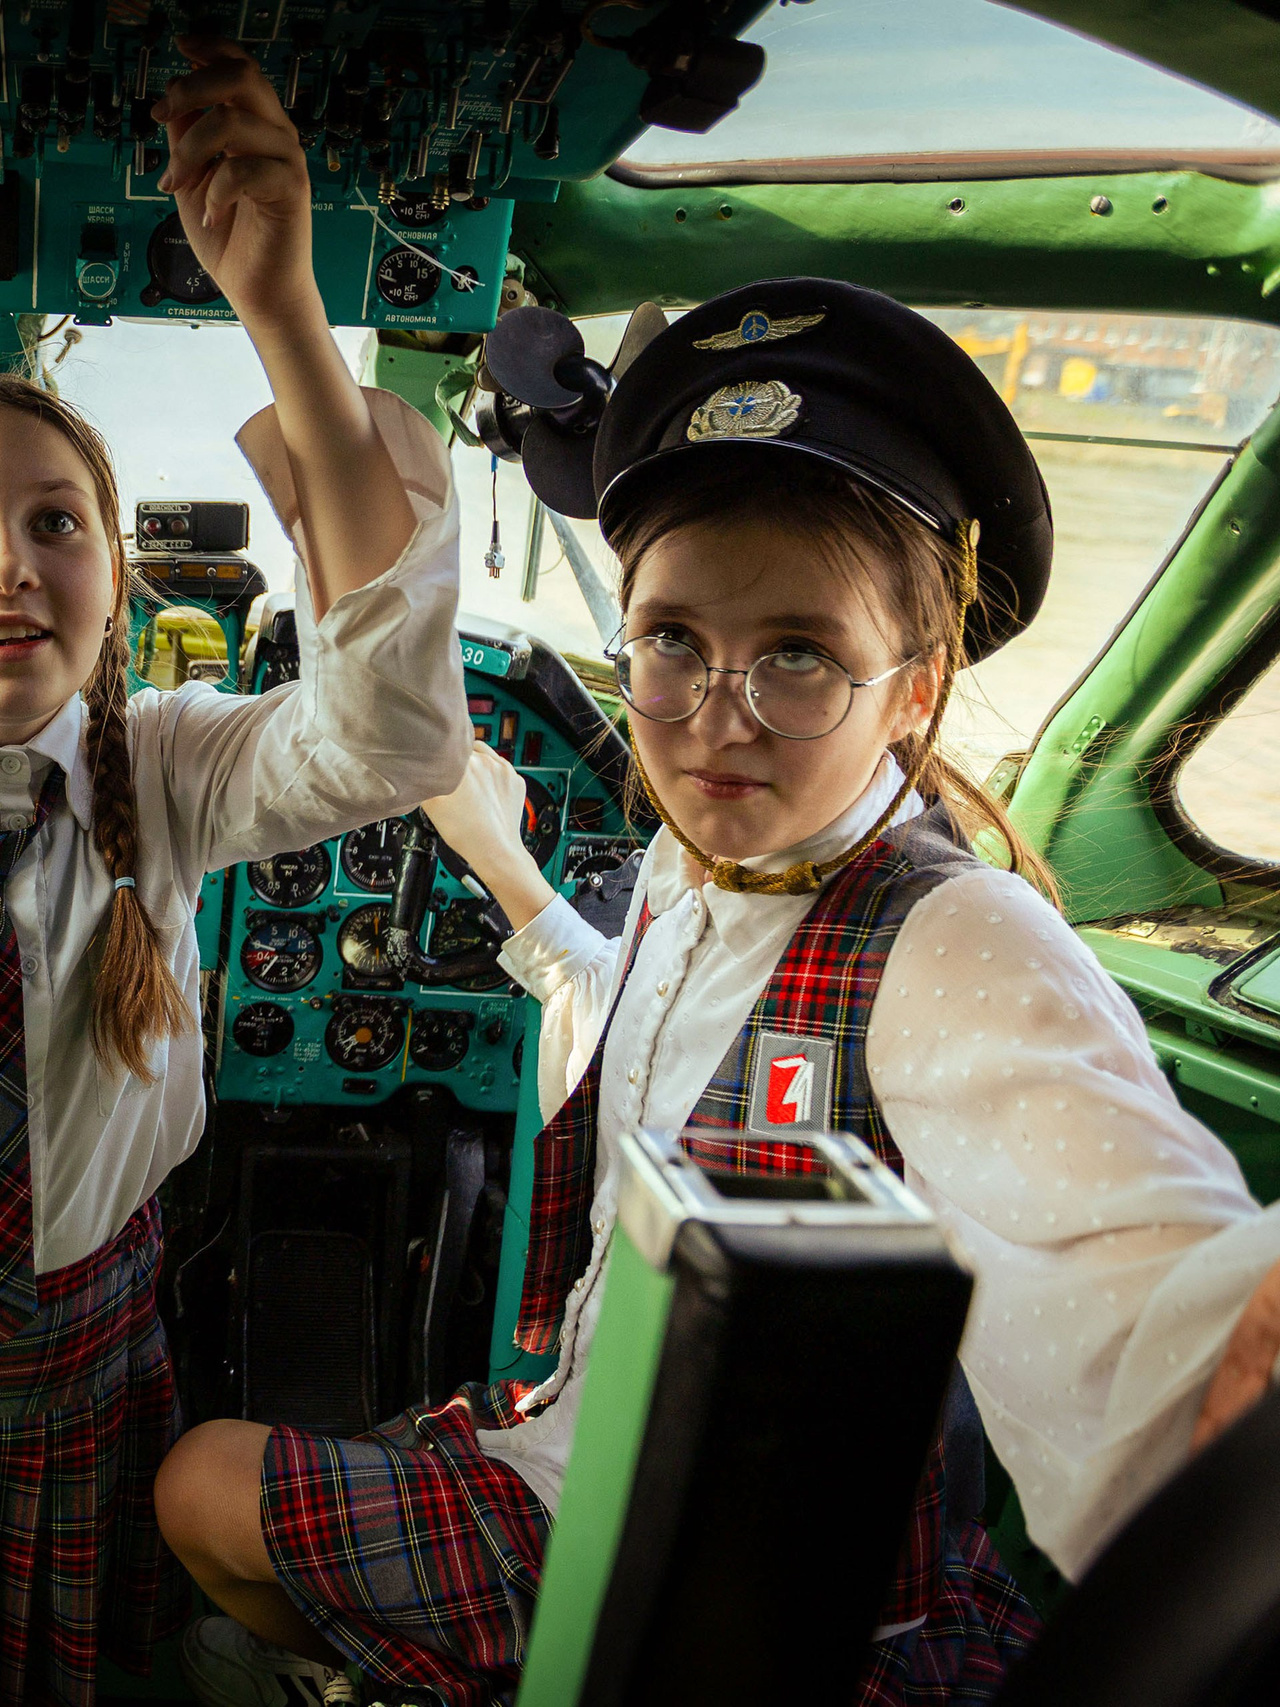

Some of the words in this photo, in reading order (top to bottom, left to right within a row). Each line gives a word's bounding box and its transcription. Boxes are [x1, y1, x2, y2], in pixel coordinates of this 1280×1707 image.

[88, 205, 115, 215] ШАССИ
[311, 203, 334, 212] МОЗА
[87, 216, 115, 224] УБРАНО
[397, 231, 438, 241] ОСНОВНАЯ
[396, 260, 404, 269] 5
[409, 260, 419, 269] 10
[417, 268, 429, 280] 15
[82, 275, 111, 285] ШАССИ
[167, 306, 236, 318] СТАБИЛИЗАТОР
[384, 314, 438, 325] АВТОНОМНАЯ
[462, 646, 485, 666] 30
[271, 925, 278, 936] 5
[288, 928, 298, 938] 10
[297, 939, 307, 949] 15
